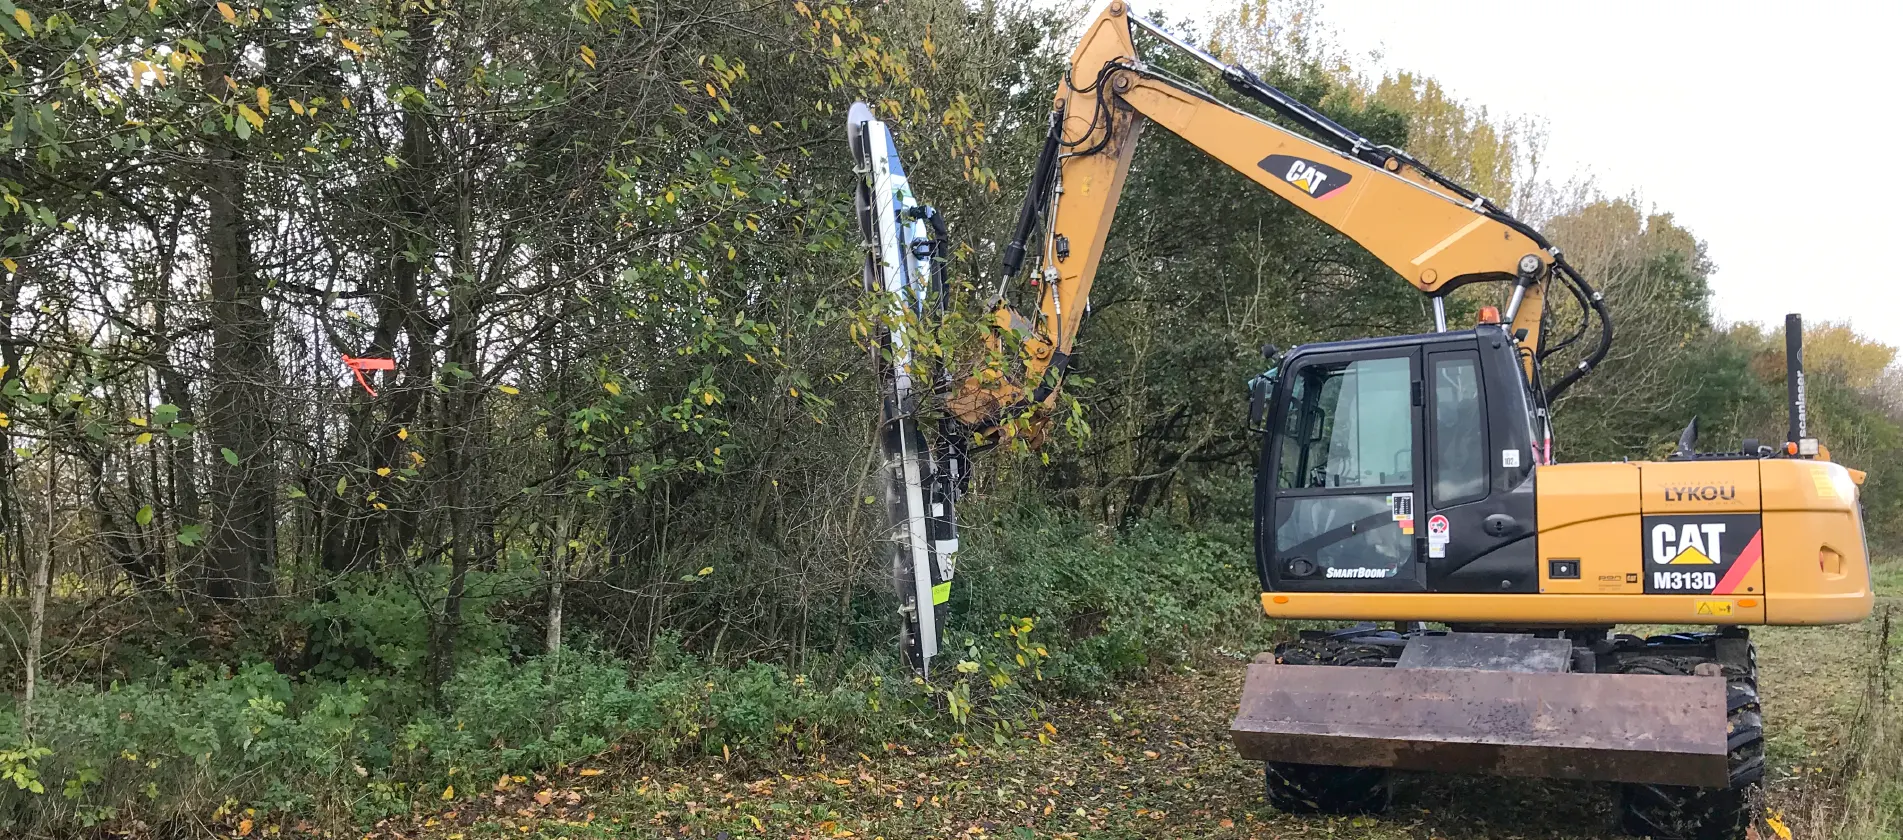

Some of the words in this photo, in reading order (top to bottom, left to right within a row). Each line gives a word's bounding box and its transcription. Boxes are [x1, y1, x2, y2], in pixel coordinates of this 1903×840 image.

[1286, 160, 1327, 194] CAT
[1795, 370, 1807, 437] scanlaser
[1665, 486, 1735, 501] LYKOU
[1652, 523, 1726, 564] CAT
[1653, 571, 1716, 589] M313D
